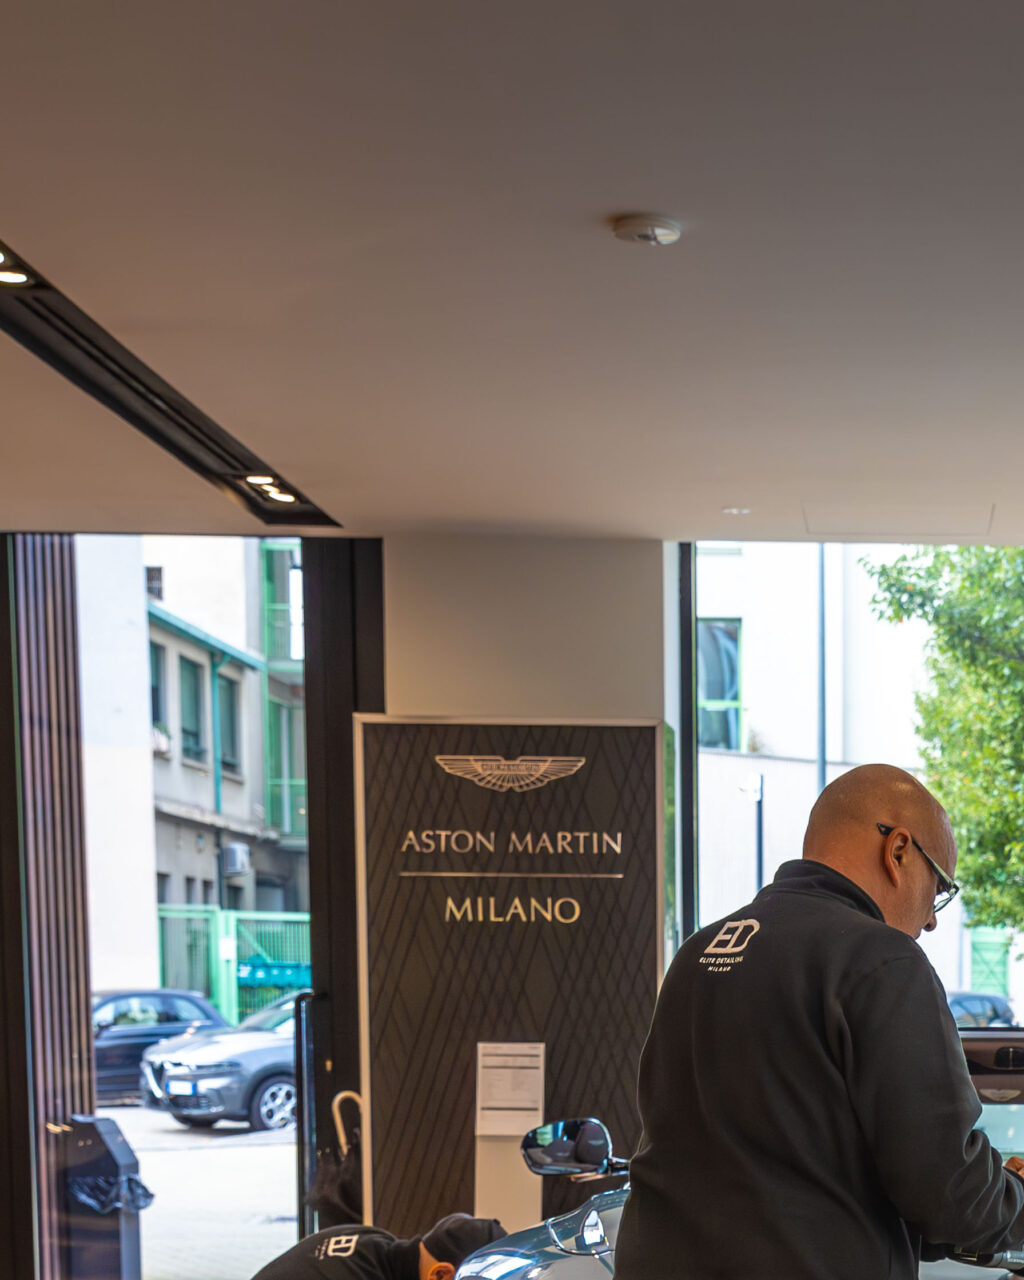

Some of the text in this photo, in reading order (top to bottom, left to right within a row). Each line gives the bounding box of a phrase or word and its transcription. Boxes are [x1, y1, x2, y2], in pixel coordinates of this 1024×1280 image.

[401, 829, 623, 854] ASTON MARTIN
[445, 896, 581, 923] MILANO
